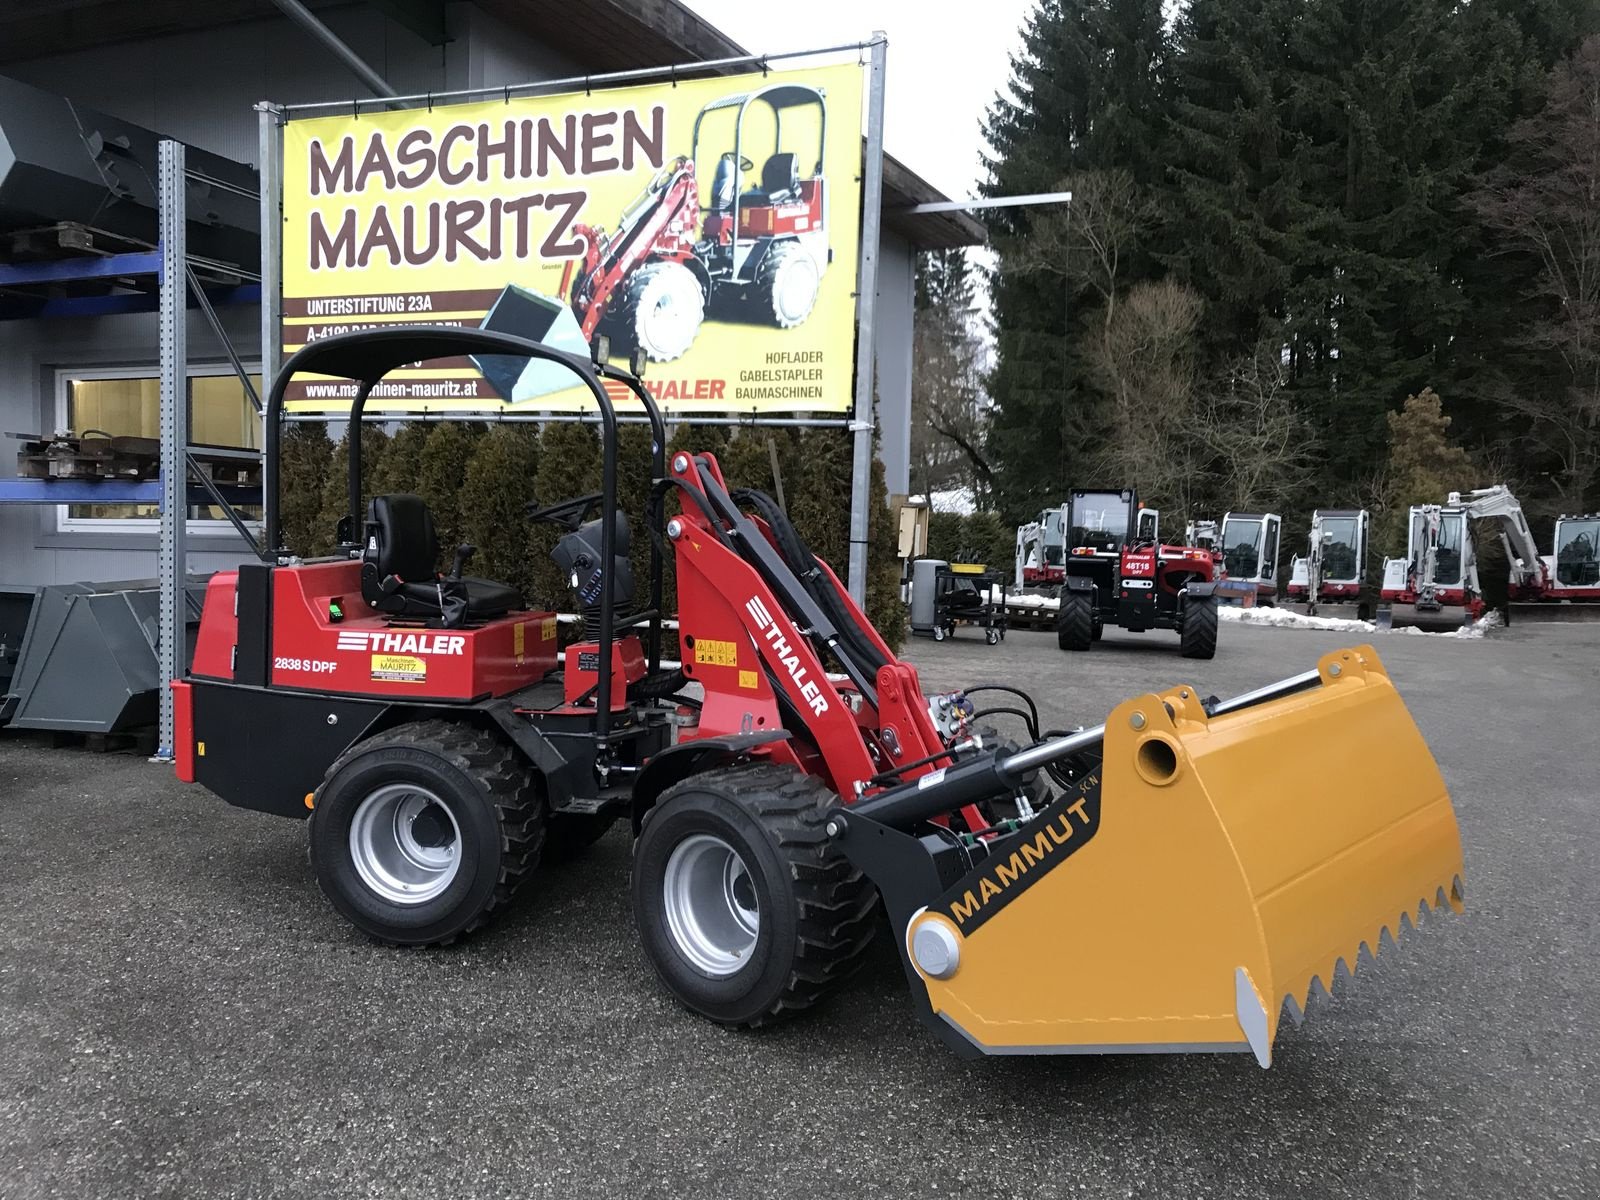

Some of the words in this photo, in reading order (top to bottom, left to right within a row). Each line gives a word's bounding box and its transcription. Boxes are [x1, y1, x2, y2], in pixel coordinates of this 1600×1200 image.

[309, 106, 664, 196] MASCHINEN
[309, 191, 588, 271] MAURITZ
[307, 296, 404, 315] UNTERSTIFTUNG
[408, 295, 432, 312] 23A
[765, 351, 823, 364] HOFLADER
[739, 369, 823, 382] GABELSTAPLER
[306, 380, 477, 398] www.mahinen-mauritz.at
[735, 386, 823, 399] BAUMASCHINEN
[1125, 562, 1150, 570] 48T18
[369, 633, 466, 655] THALER
[274, 657, 301, 670] 2838
[302, 659, 311, 672] S
[312, 661, 337, 673] DPF
[380, 662, 417, 671] MAURITZ
[765, 621, 829, 718] THALER
[950, 797, 1090, 924] MAMMUT
